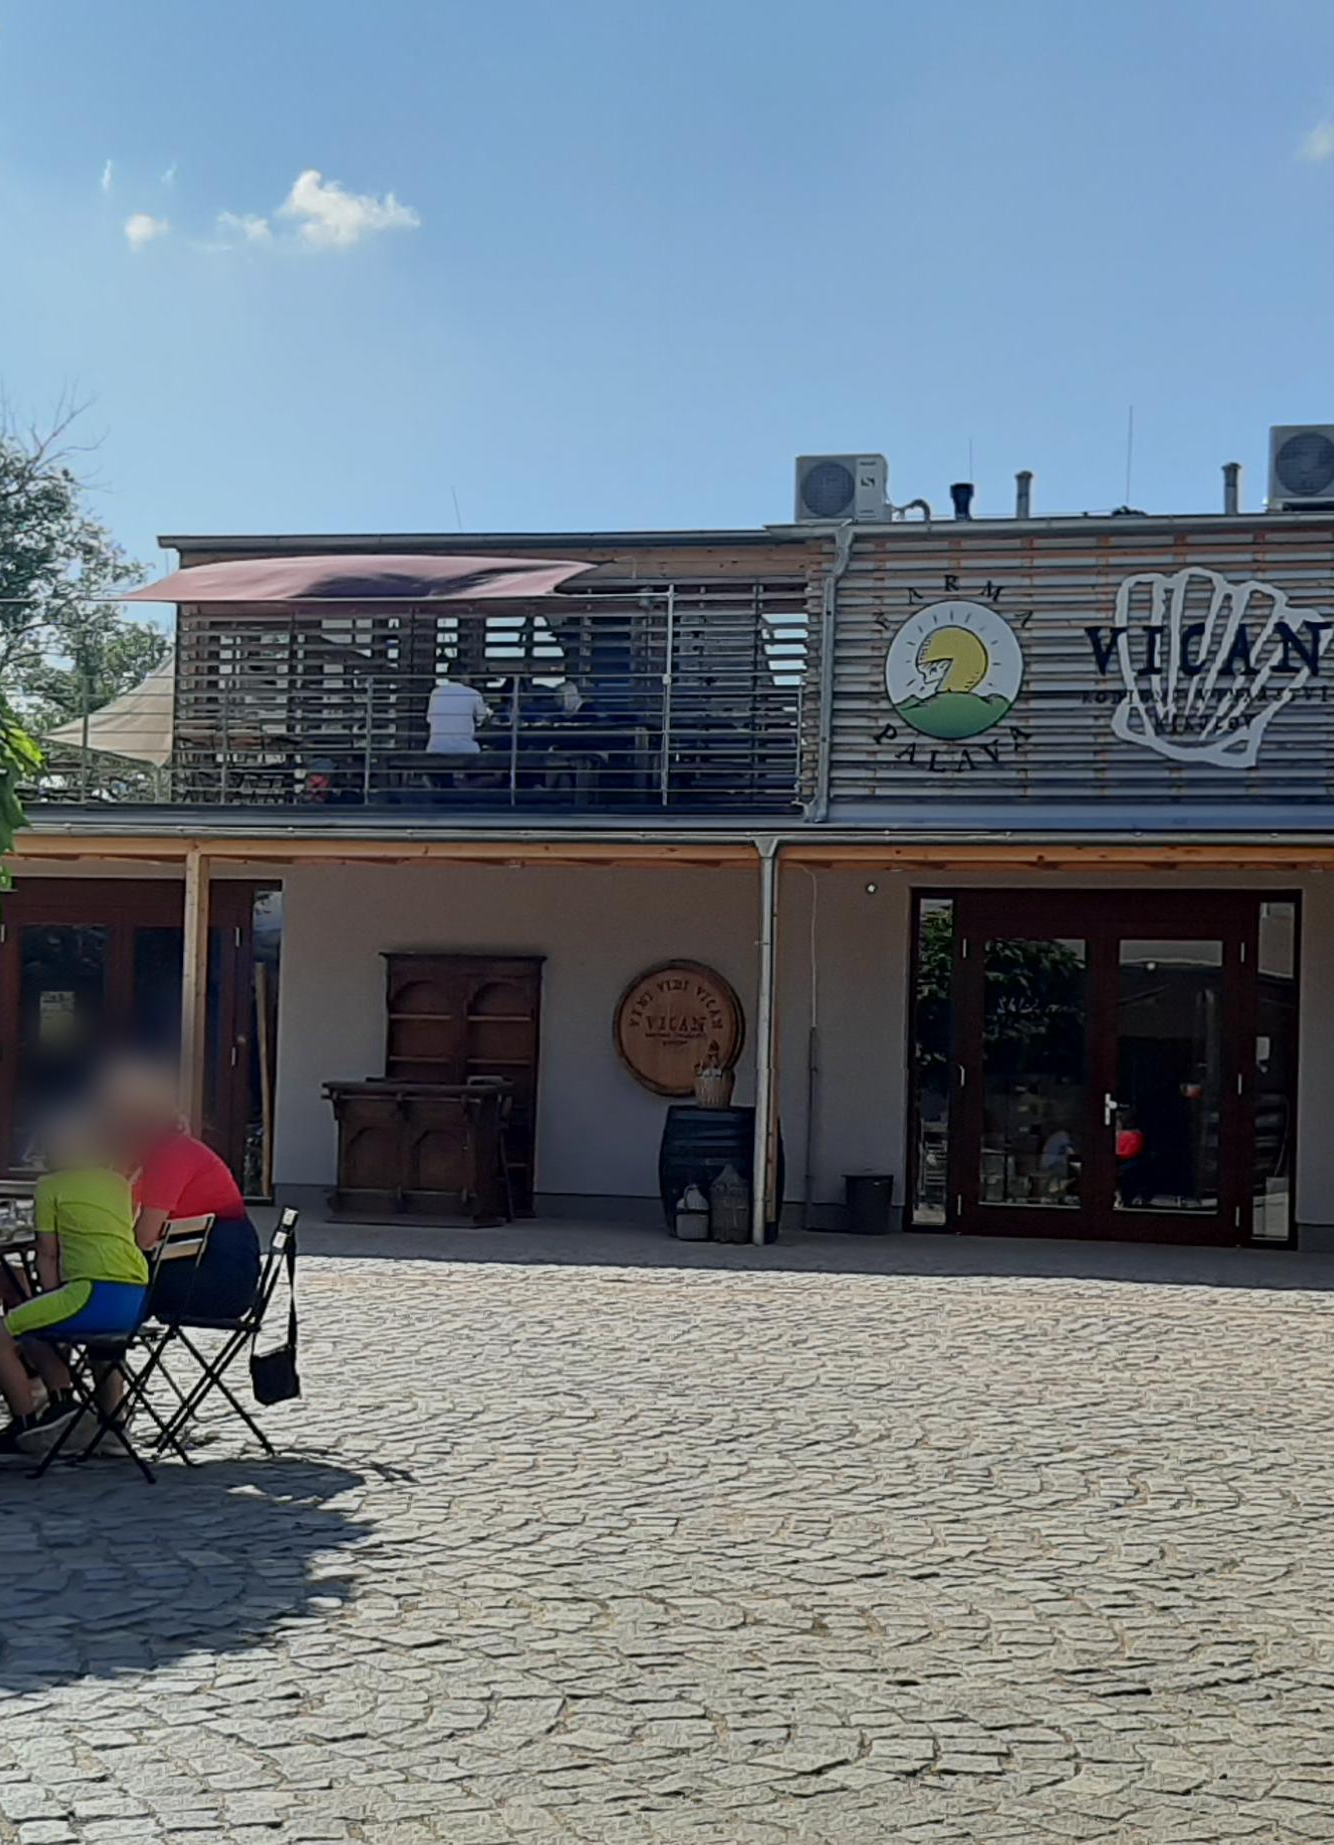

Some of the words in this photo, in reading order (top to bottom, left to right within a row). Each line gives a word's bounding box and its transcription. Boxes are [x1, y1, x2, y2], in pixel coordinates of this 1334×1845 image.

[872, 574, 1034, 630] FARMA
[1084, 620, 1333, 676] VICAN
[872, 723, 1033, 773] PALAVA
[645, 1015, 707, 1032] VICAN
